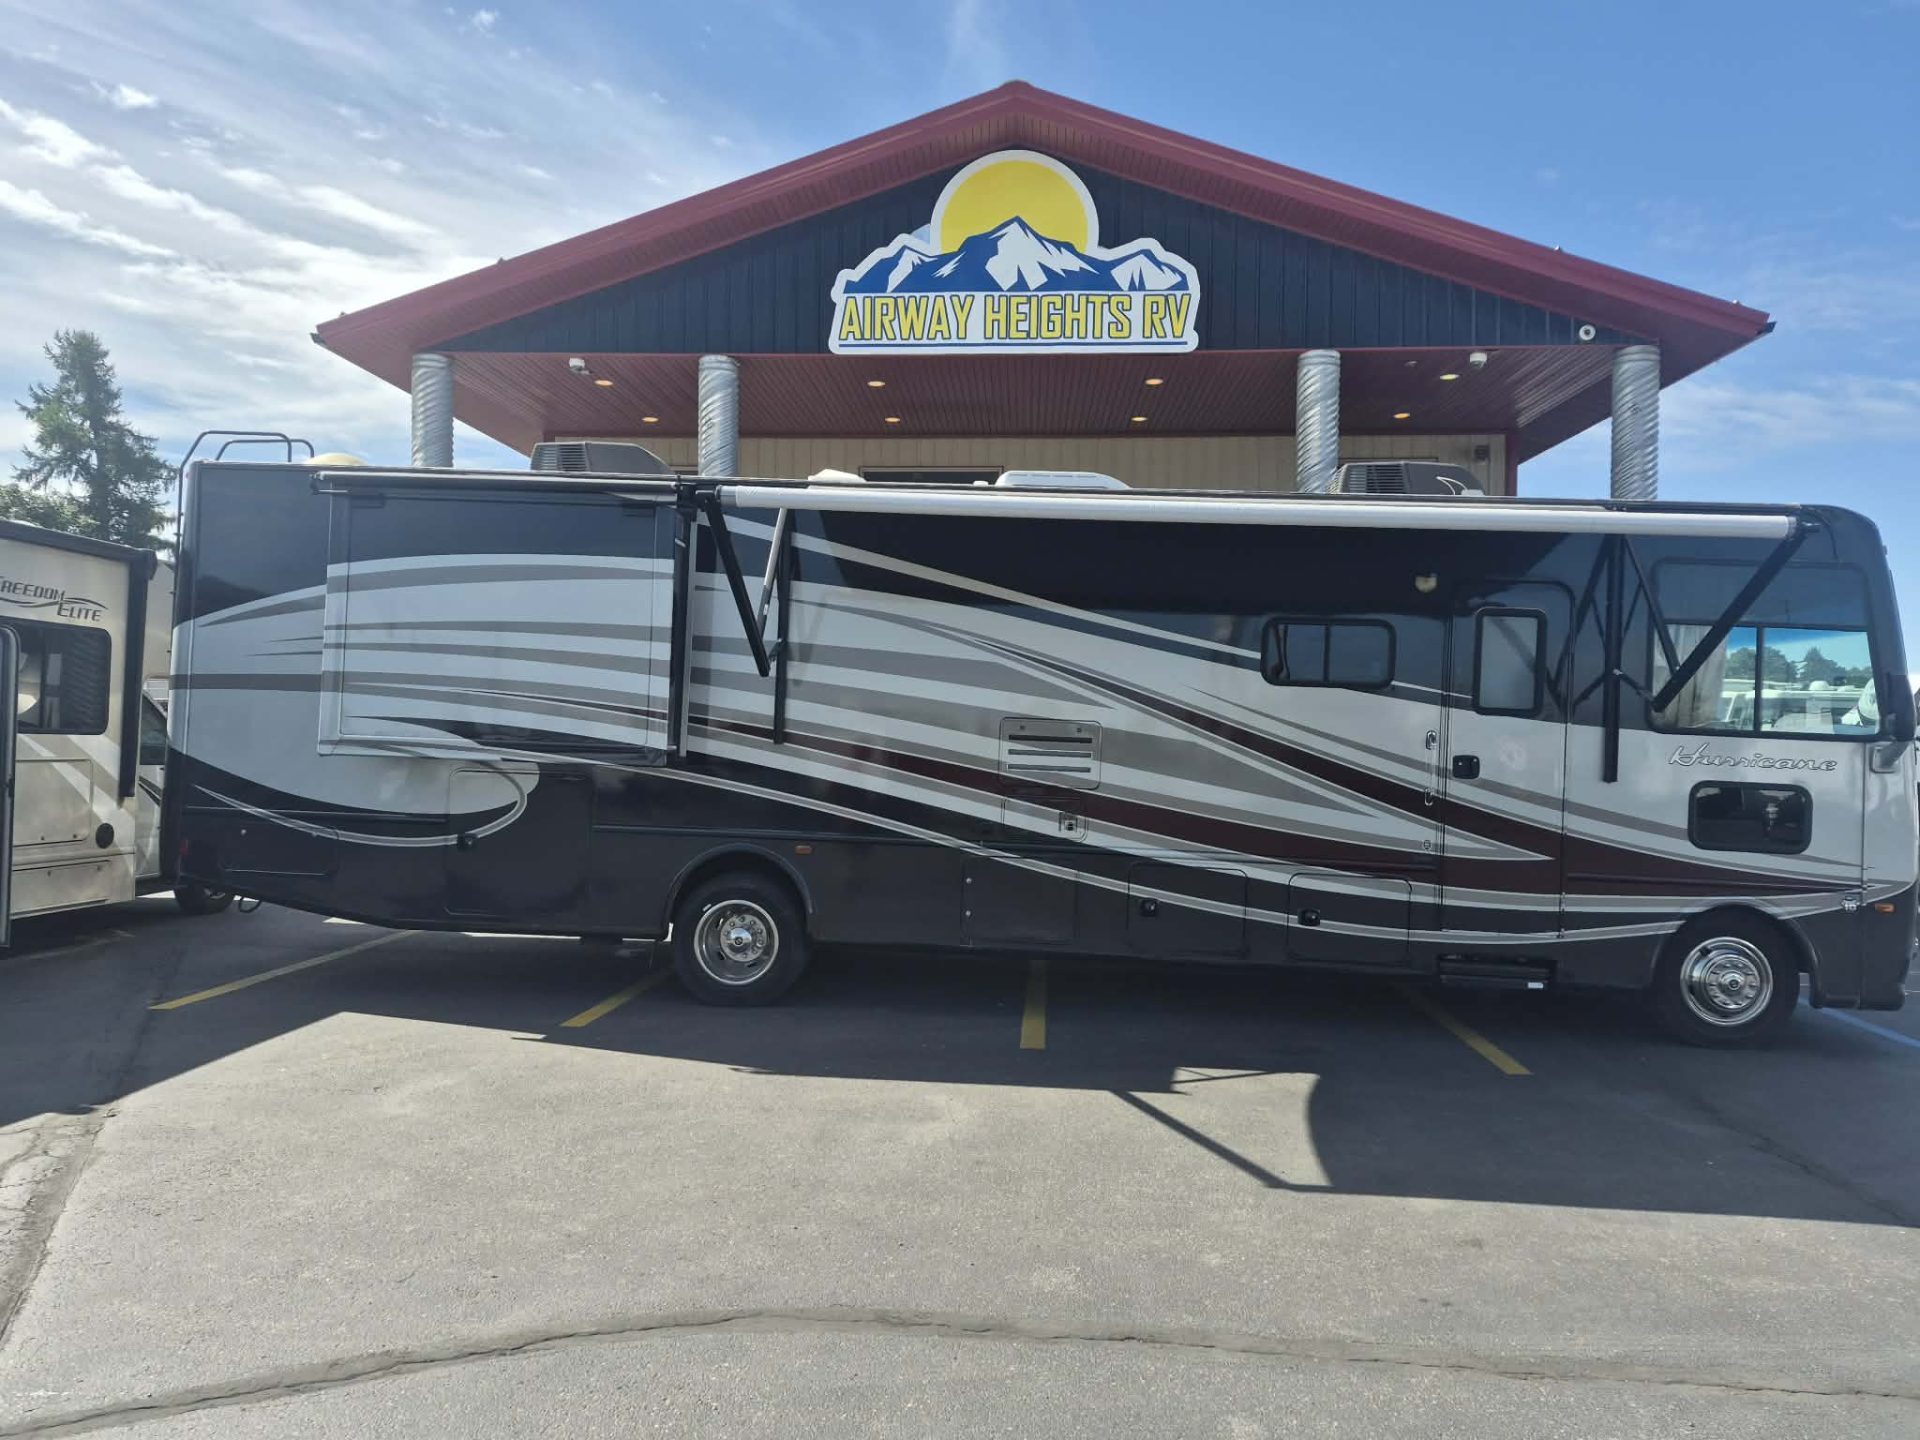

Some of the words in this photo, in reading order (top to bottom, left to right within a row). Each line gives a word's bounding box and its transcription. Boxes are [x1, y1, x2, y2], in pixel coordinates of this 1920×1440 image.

[838, 294, 974, 340] AIRWAY
[983, 294, 1132, 340] HEIGHTS
[1143, 294, 1191, 339] RV
[0, 576, 66, 601] REEDOM
[1668, 742, 1838, 772] Hurricane
